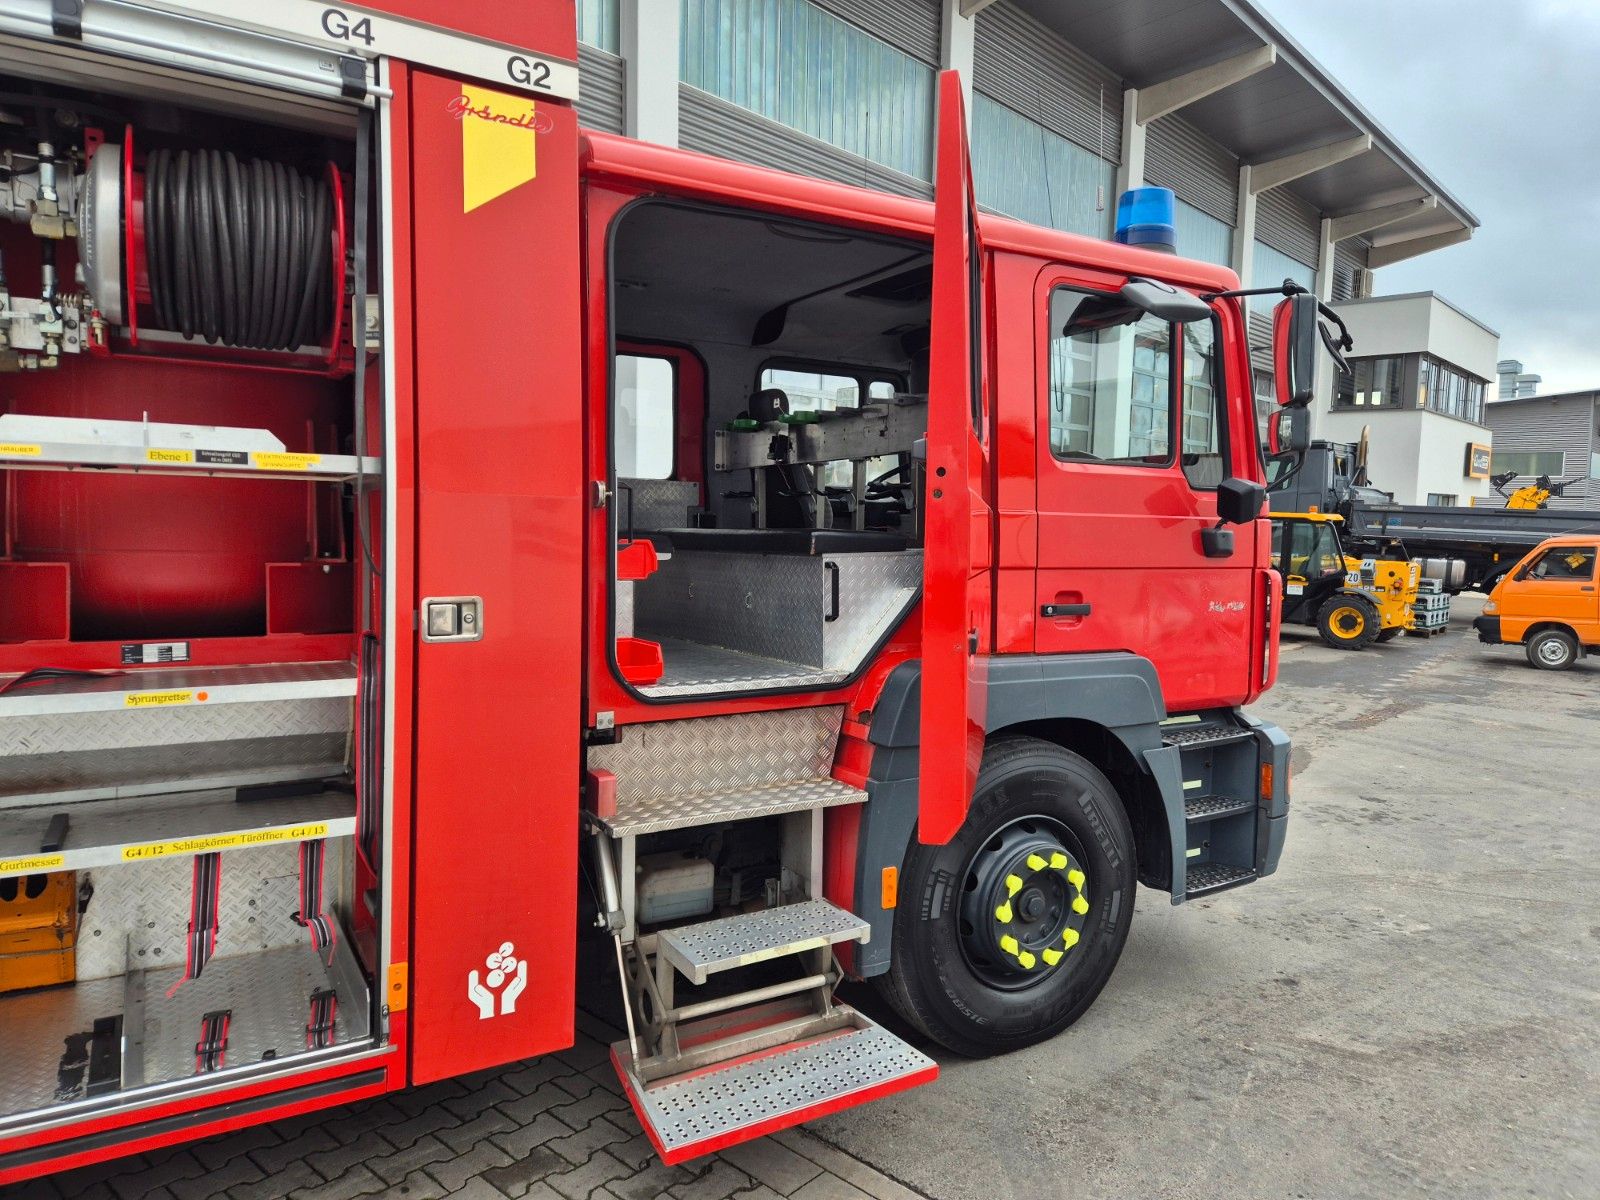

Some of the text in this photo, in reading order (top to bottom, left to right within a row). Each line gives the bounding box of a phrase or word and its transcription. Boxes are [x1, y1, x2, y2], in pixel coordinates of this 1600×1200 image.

[321, 8, 375, 46] G4
[506, 55, 552, 90] G2
[150, 451, 190, 462] Ebene 1
[1347, 573, 1359, 583] 20
[125, 848, 142, 858] G4
[152, 845, 164, 855] 12
[173, 836, 235, 851] Schlagkörner
[240, 830, 283, 844] Türöffner
[291, 828, 306, 838] G4
[314, 826, 325, 835] 13
[1077, 789, 1123, 869] PIRELLI
[0, 857, 62, 871] Gurtmesser
